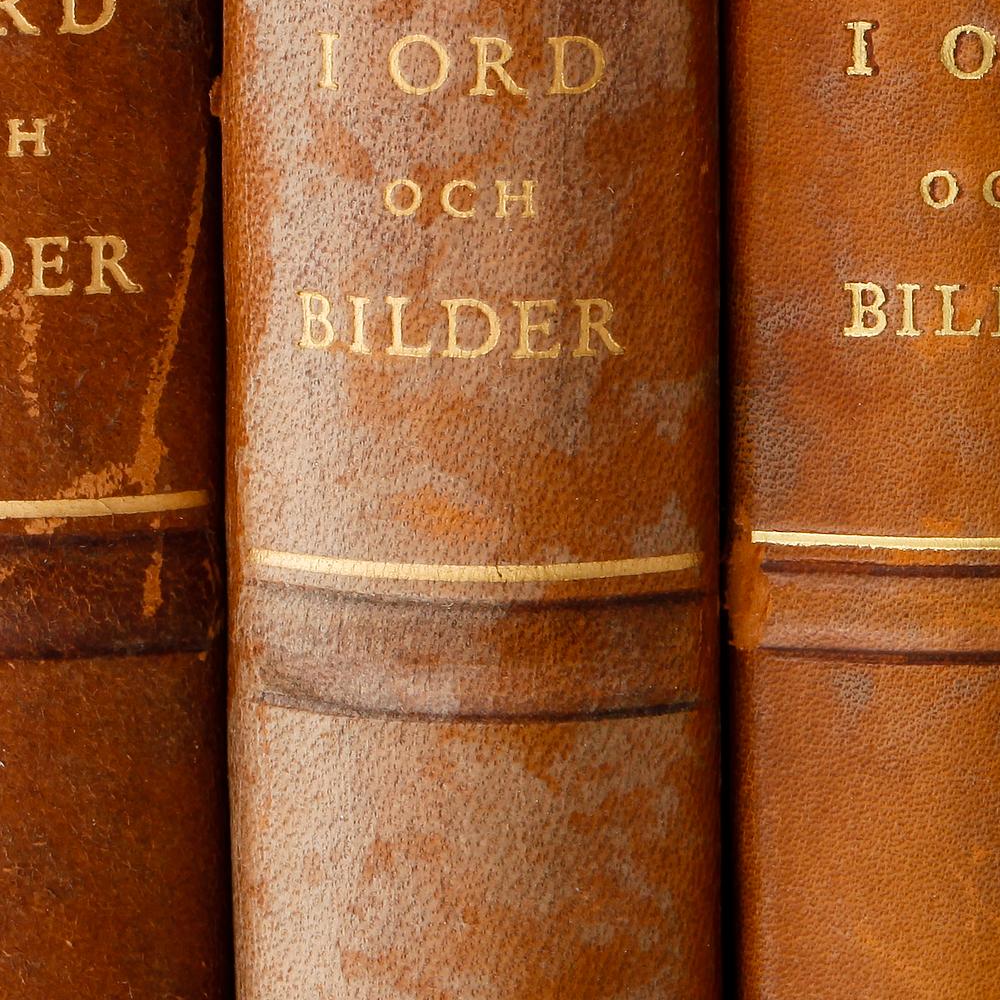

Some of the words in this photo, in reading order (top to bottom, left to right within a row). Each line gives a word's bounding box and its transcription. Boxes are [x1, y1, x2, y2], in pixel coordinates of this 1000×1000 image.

[316, 32, 339, 91] I
[387, 33, 608, 99] ORD
[845, 20, 874, 77] I
[384, 178, 538, 219] OCH
[0, 234, 143, 297] ER
[297, 292, 624, 359] BILDER
